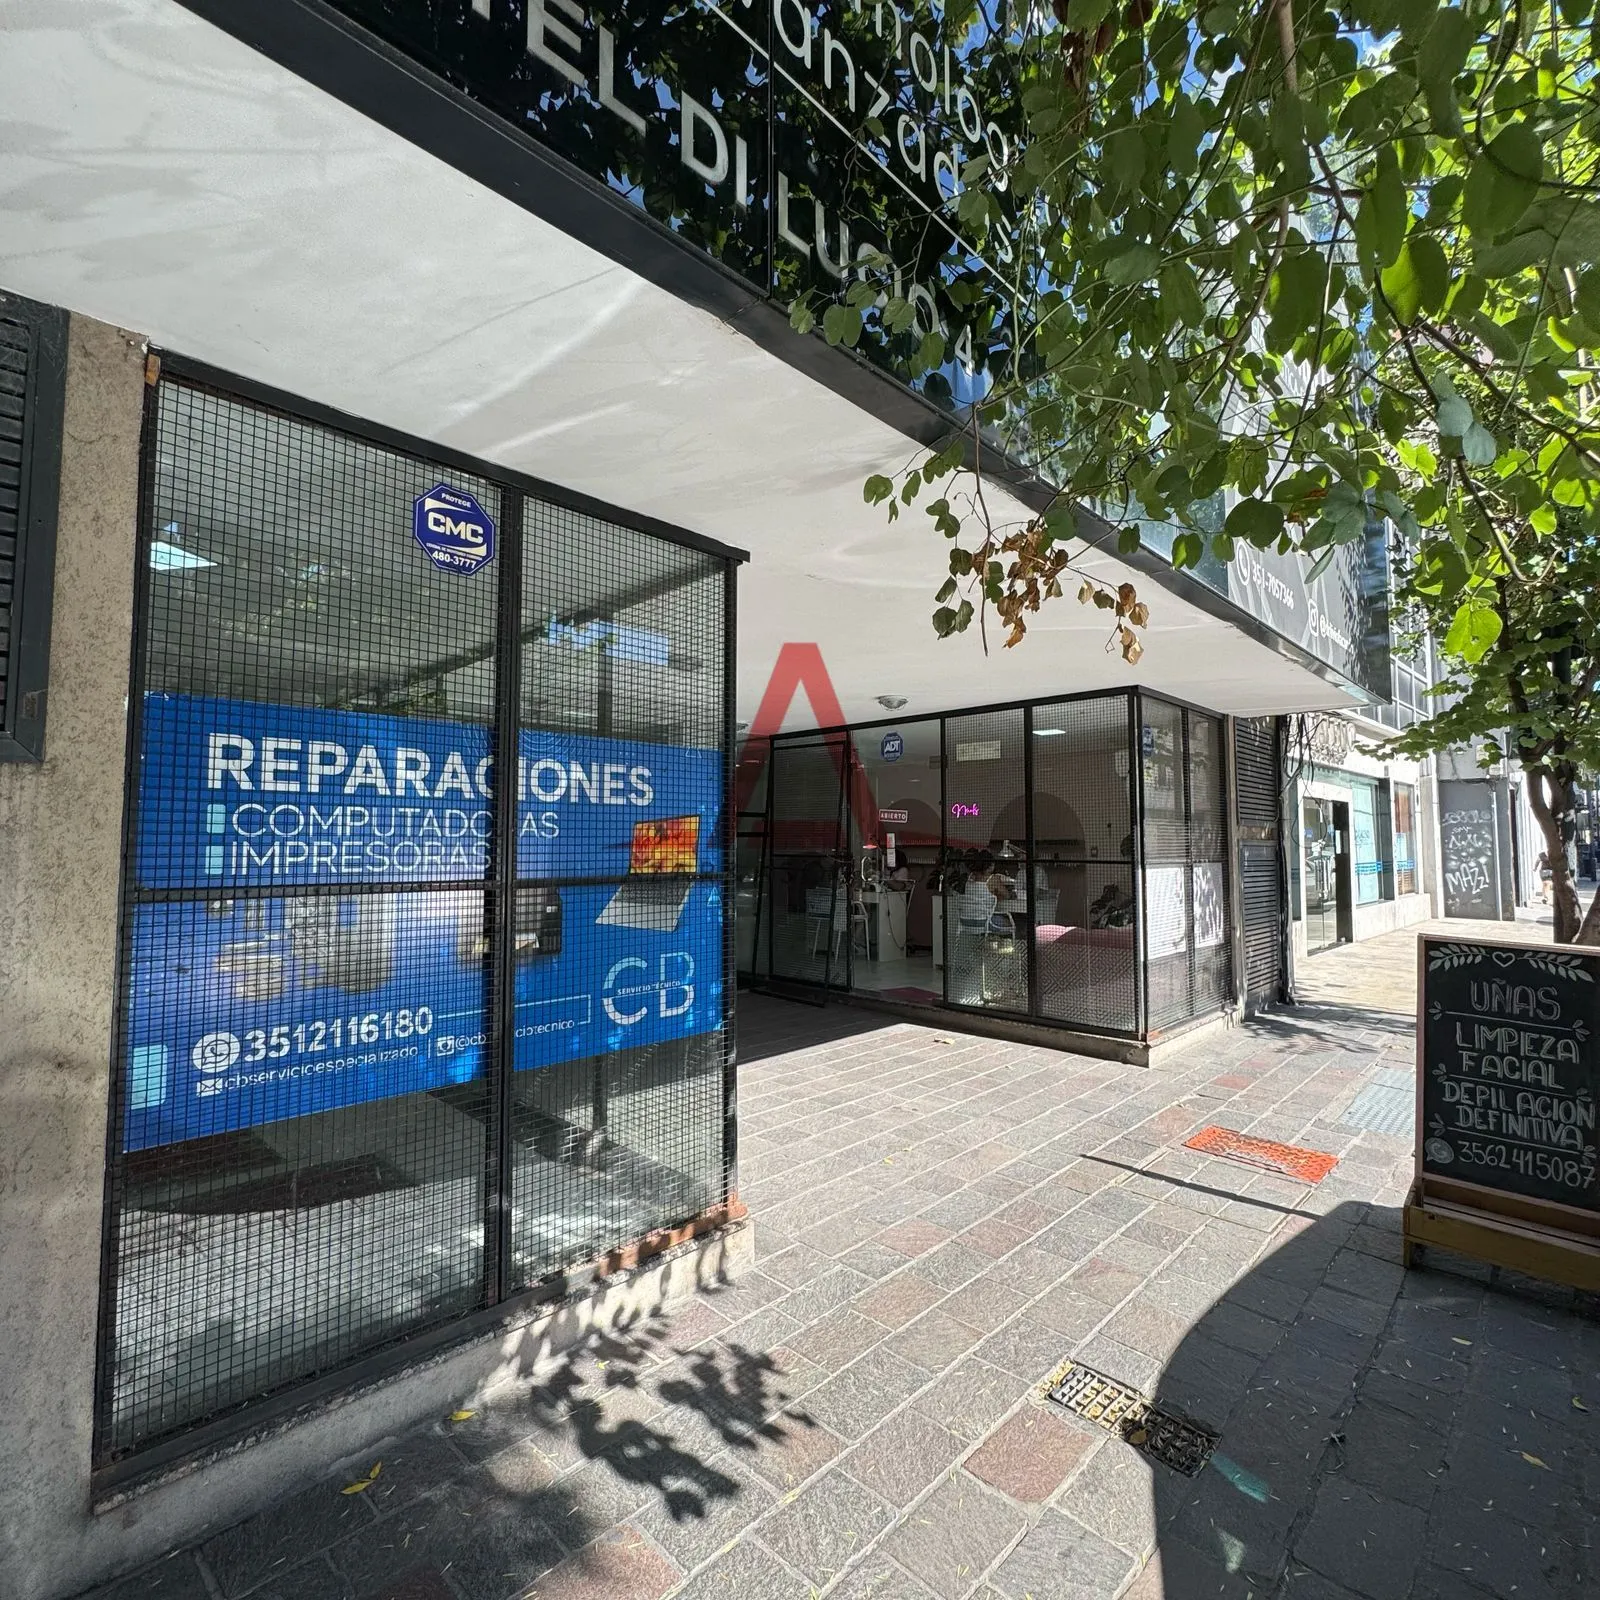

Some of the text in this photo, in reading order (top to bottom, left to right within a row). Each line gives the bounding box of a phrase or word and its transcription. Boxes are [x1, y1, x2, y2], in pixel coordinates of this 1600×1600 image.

[681, 90, 748, 207] DI
[441, 493, 472, 508] PROTEGE
[428, 511, 484, 544] CMC
[432, 550, 477, 569] 480-3777
[884, 740, 901, 753] ADT
[207, 732, 654, 806] REPARACIONES
[231, 803, 560, 839] COMPUTADOAS
[880, 812, 907, 821] ABIERTO
[229, 841, 491, 876] IMPRESORAS
[1470, 977, 1561, 1021] UÑAS
[244, 1006, 433, 1062] 3512116180
[1456, 1021, 1580, 1064] LIMPIEZA
[1458, 1050, 1566, 1090] FACIAL
[1455, 1105, 1584, 1150] DEFINITIVA
[1457, 1140, 1597, 1189] 3562415087
